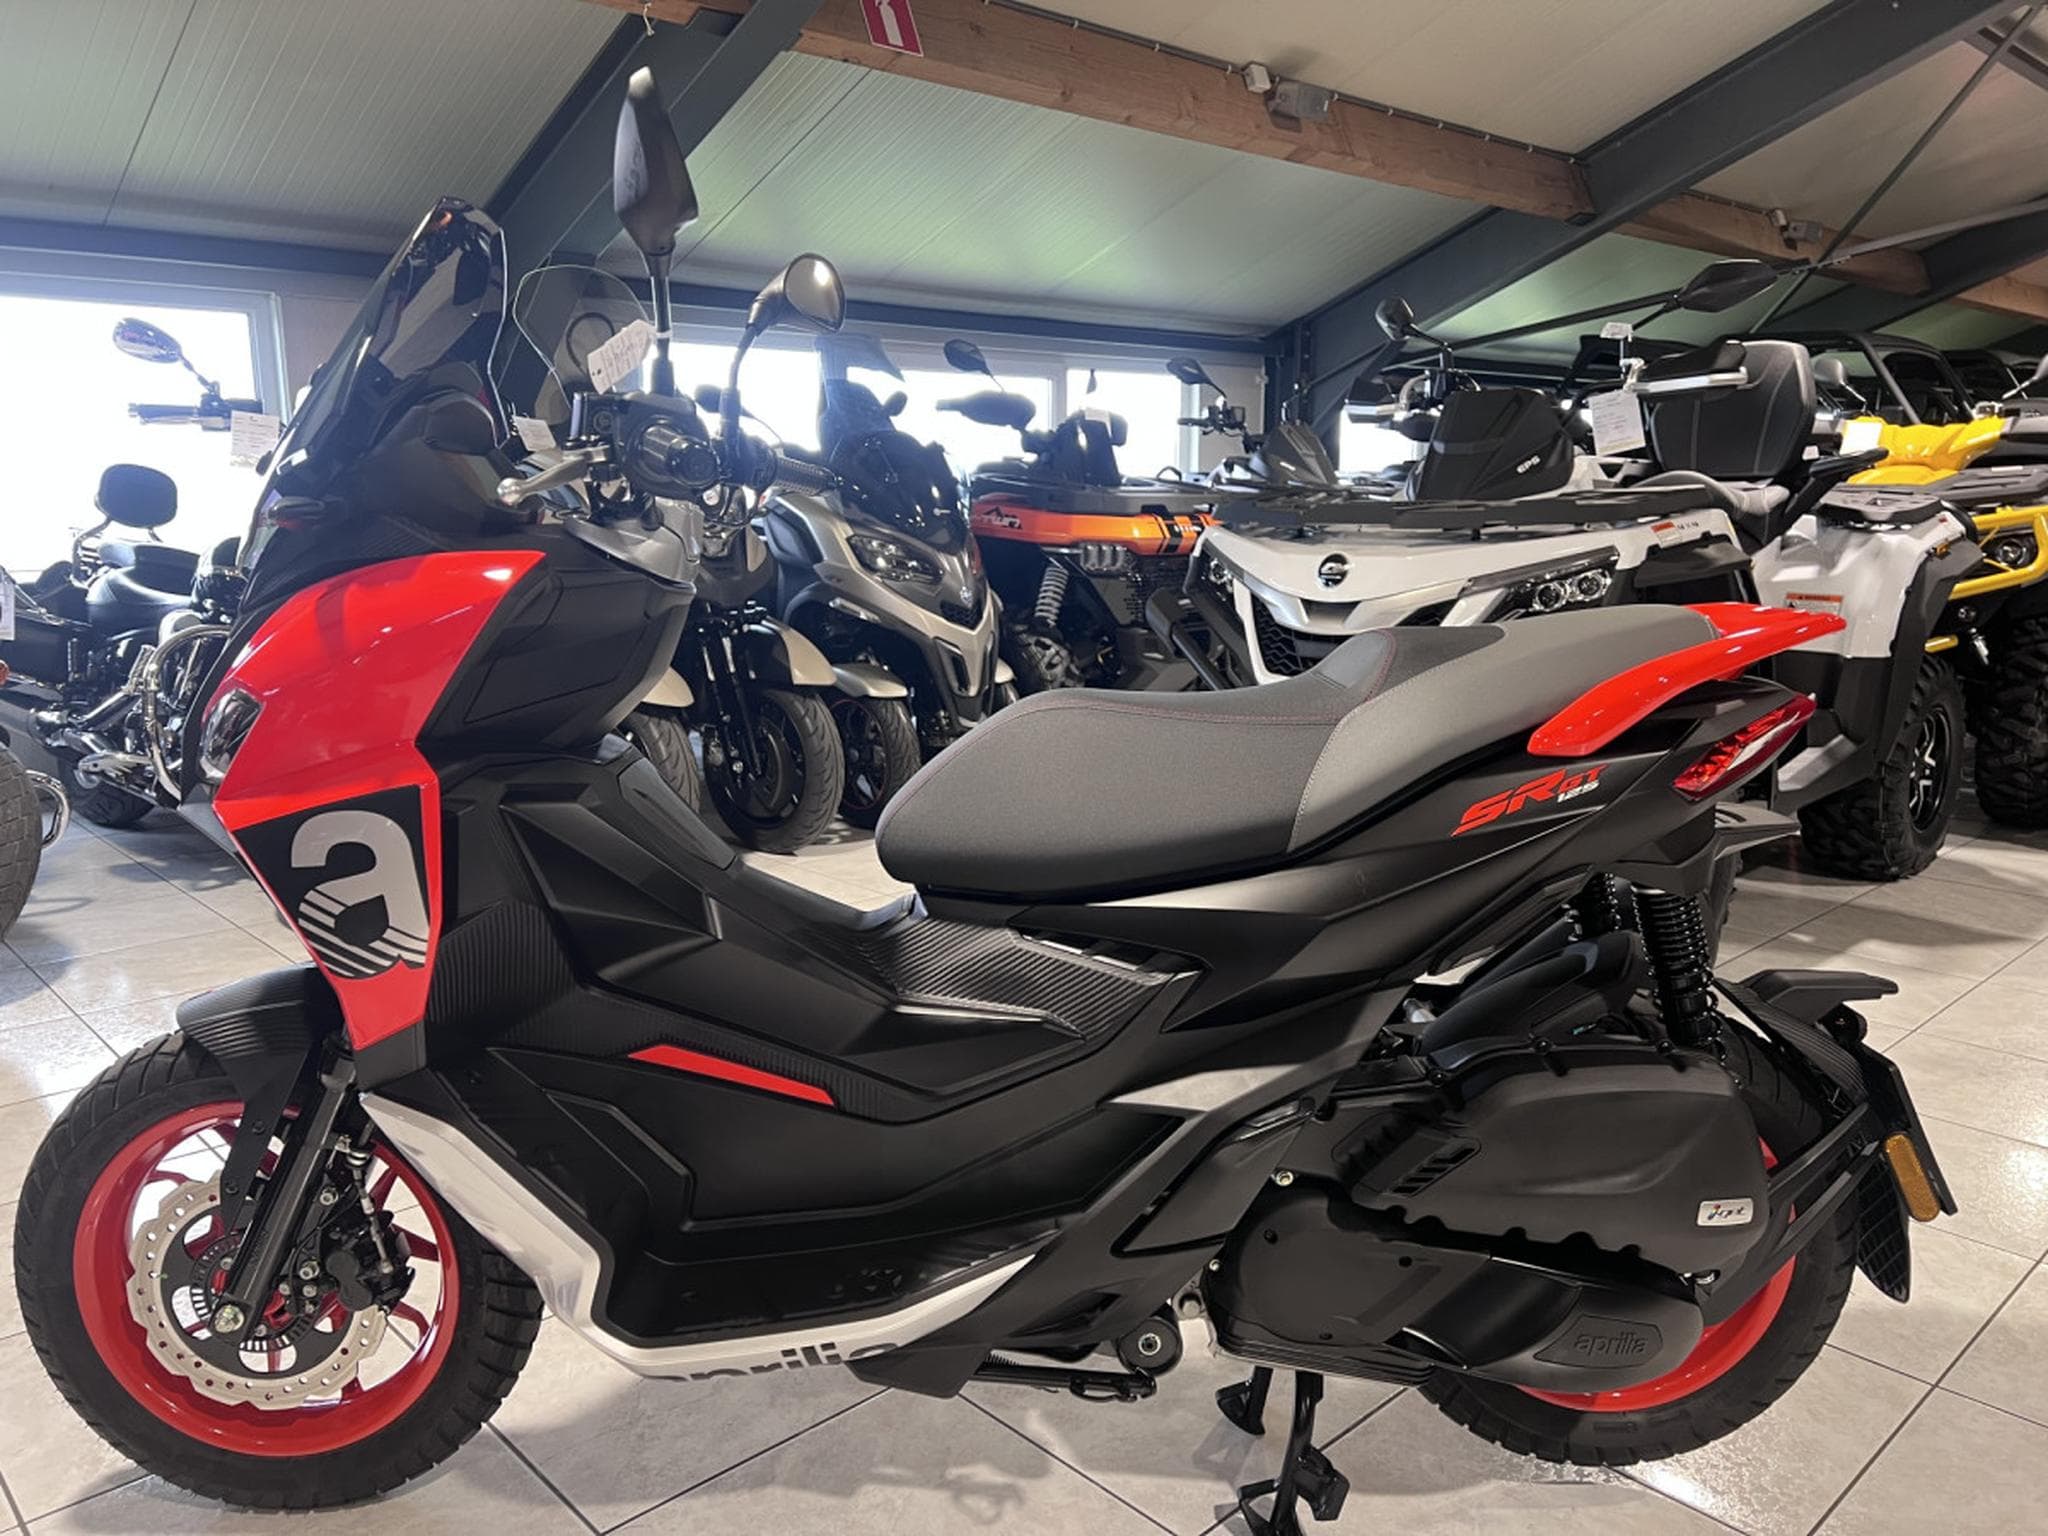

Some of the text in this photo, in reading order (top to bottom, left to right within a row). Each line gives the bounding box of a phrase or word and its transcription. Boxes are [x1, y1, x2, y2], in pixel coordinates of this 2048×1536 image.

[1516, 455, 1541, 474] EPS
[1557, 779, 1600, 803] 125
[1574, 1331, 1647, 1356] aprilia
